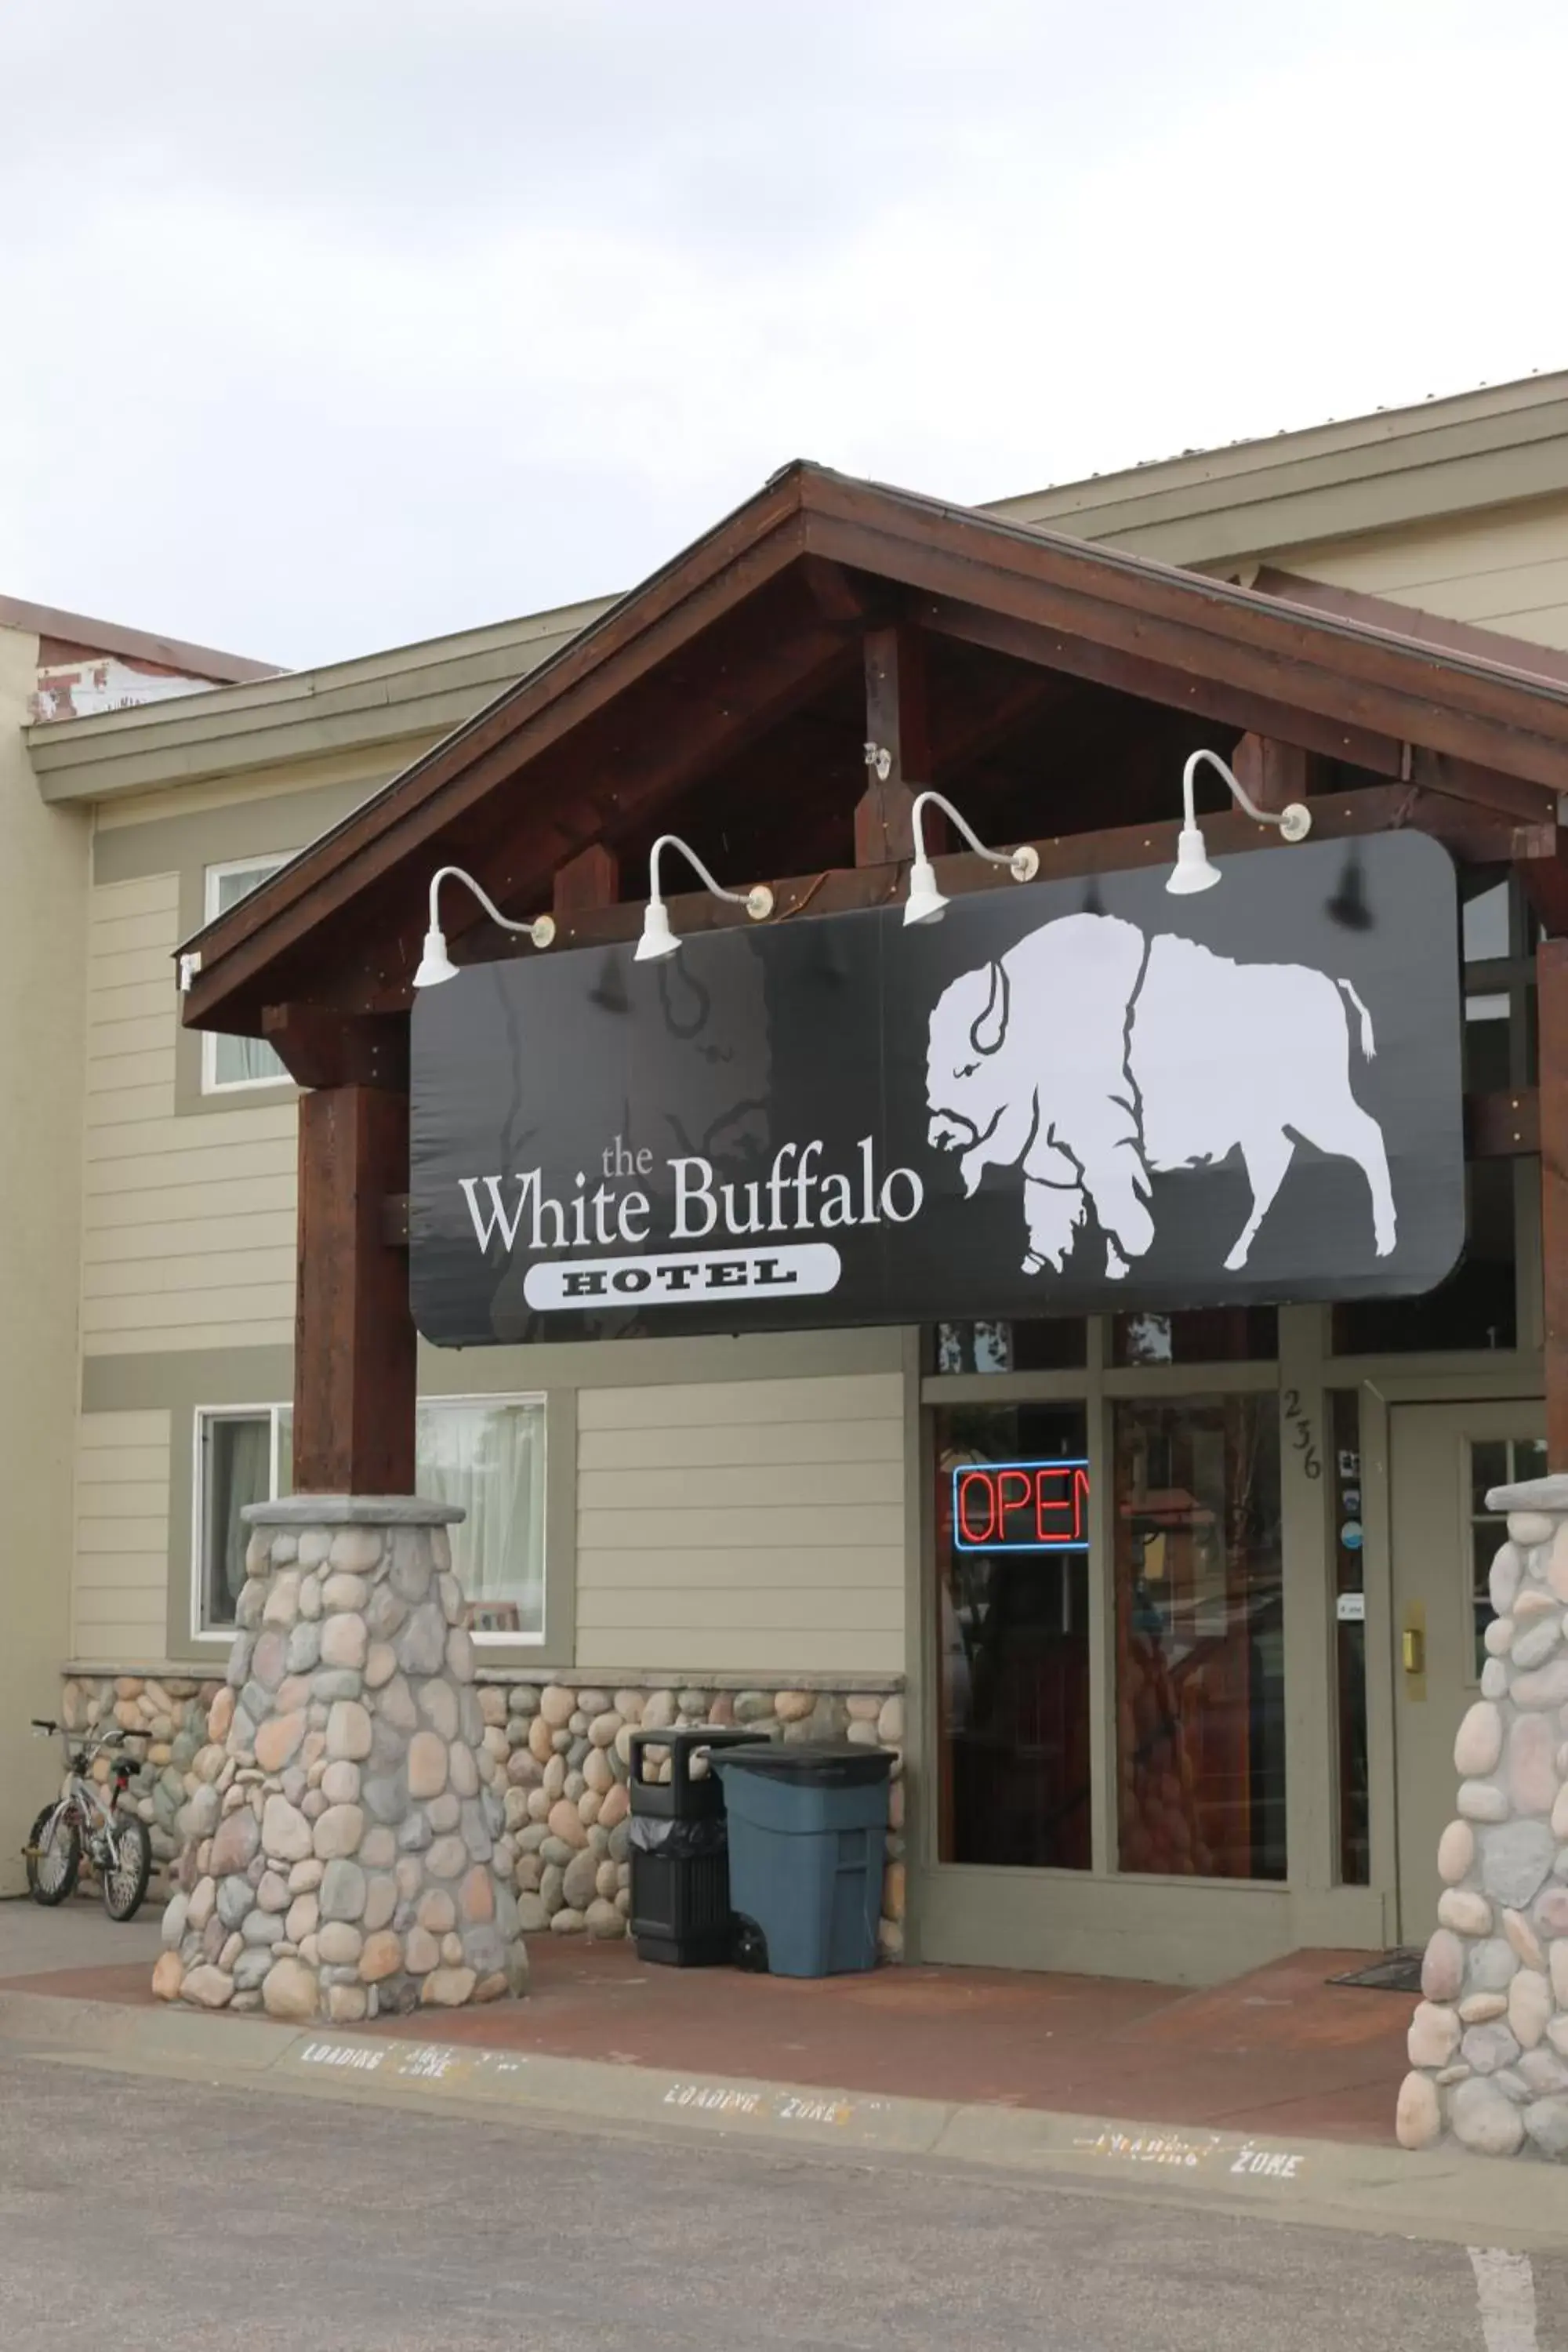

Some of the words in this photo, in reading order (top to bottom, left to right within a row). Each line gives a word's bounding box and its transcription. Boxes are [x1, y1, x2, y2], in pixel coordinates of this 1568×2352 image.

[601, 1134, 653, 1178] the
[459, 1167, 650, 1255] White
[667, 1134, 924, 1240] Buffalo
[561, 1258, 797, 1298] HOTEL
[1283, 1388, 1322, 1480] 236
[301, 2042, 384, 2071] LOADING
[663, 2083, 760, 2114] LOADING
[779, 2096, 837, 2122] ZONE
[1229, 2150, 1304, 2177] ZONE
